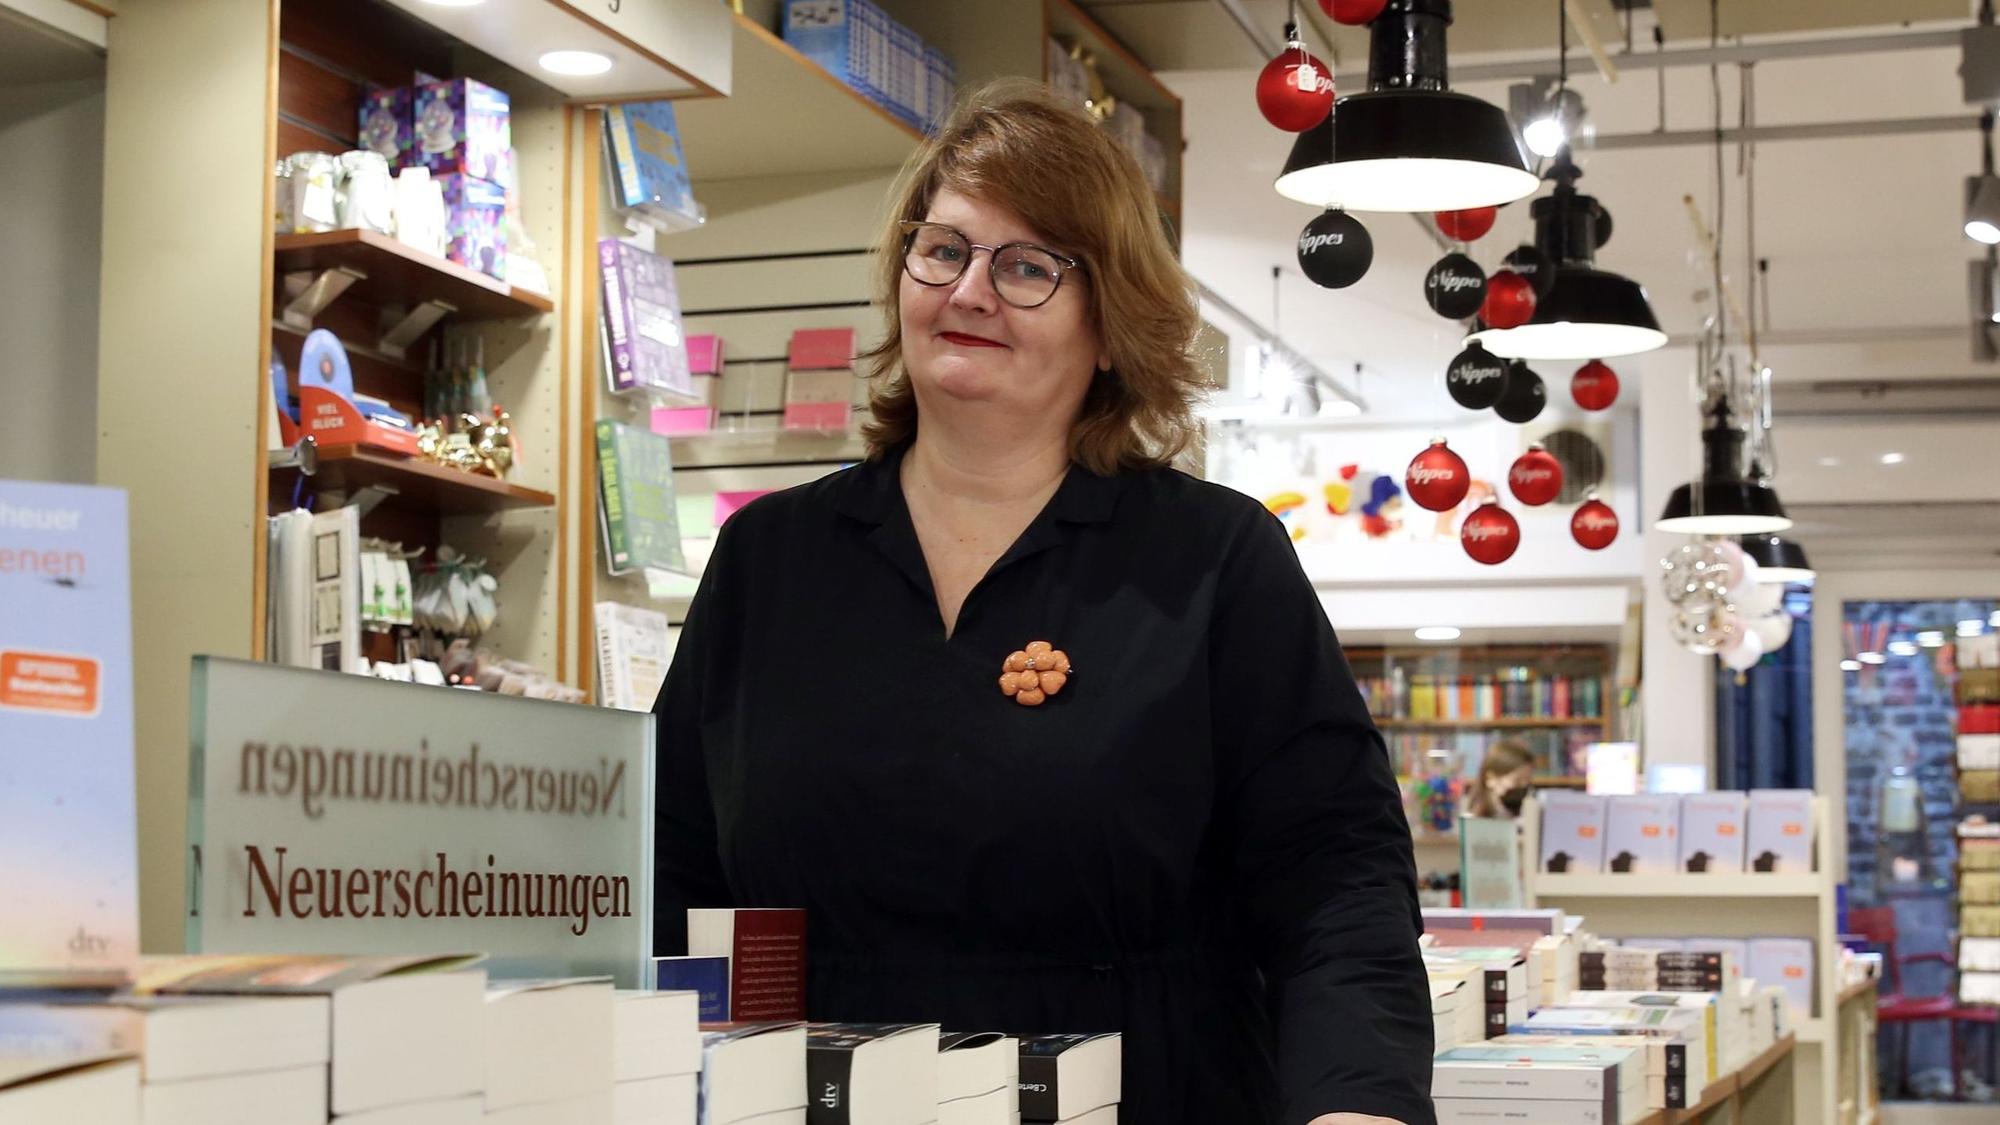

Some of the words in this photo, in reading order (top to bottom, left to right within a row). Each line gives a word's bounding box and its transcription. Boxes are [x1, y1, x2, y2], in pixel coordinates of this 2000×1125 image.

[1428, 268, 1482, 292] Nippes
[1450, 361, 1502, 385] Nippes
[243, 845, 633, 937] Neuerscheinungen
[820, 1082, 837, 1108] dtv
